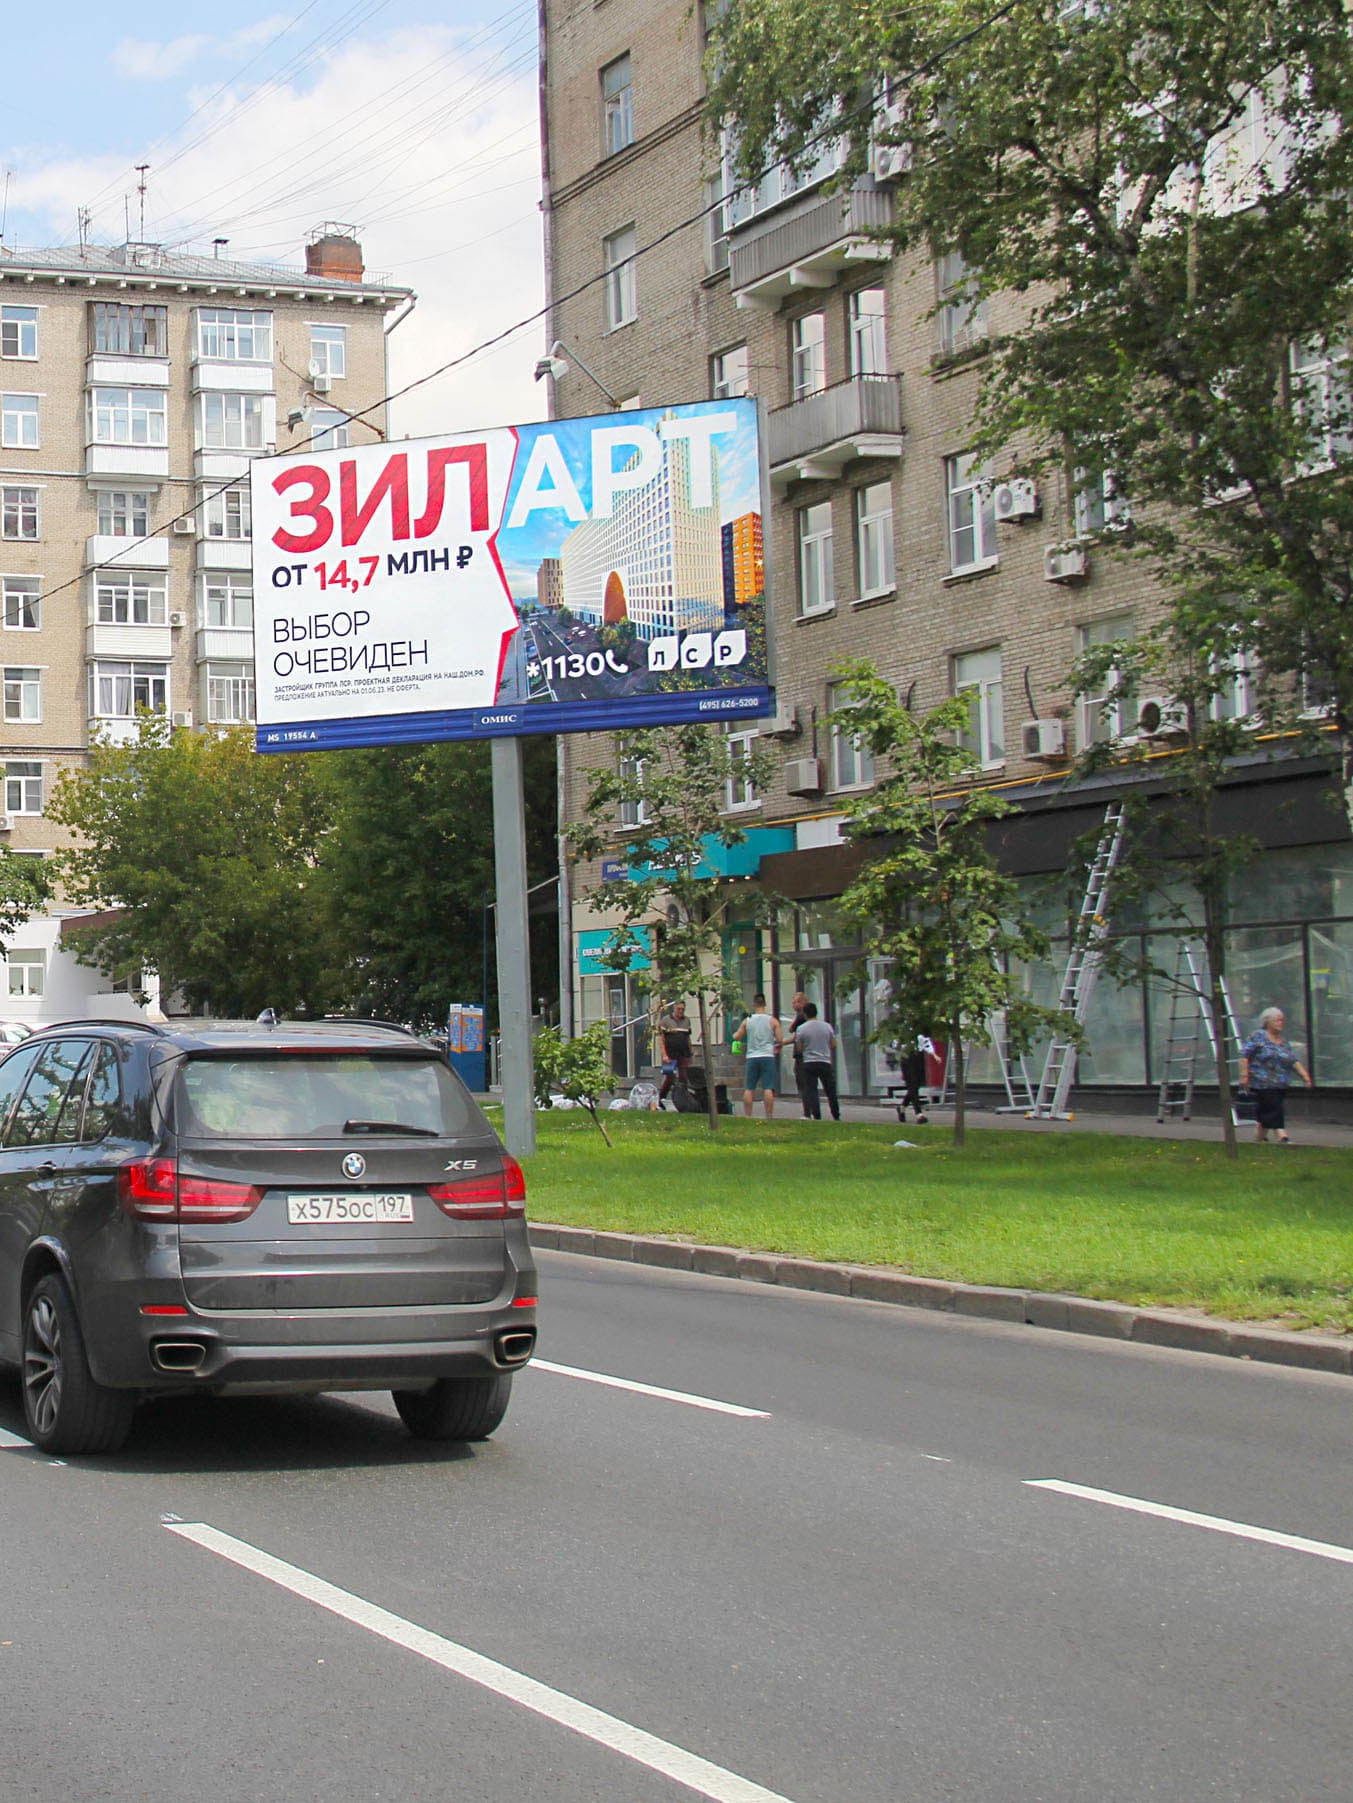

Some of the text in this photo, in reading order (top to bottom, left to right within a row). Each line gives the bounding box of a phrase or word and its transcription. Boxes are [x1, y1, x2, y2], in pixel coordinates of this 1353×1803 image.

[272, 564, 308, 588] ОТ
[314, 555, 380, 593] 14,7
[387, 547, 449, 576] МЛН
[273, 610, 370, 643] ВЫБОР
[273, 640, 428, 677] ОЧЕВИДЕН
[315, 681, 338, 689] ГРУППА
[354, 676, 390, 687] ПРОЕКТНАЯ
[391, 673, 432, 684] ДЕКЛАРАЦИЯ
[434, 672, 443, 680] НА
[721, 697, 758, 708] 626-5200
[480, 714, 518, 725] ОМИС
[443, 1159, 478, 1171] X5
